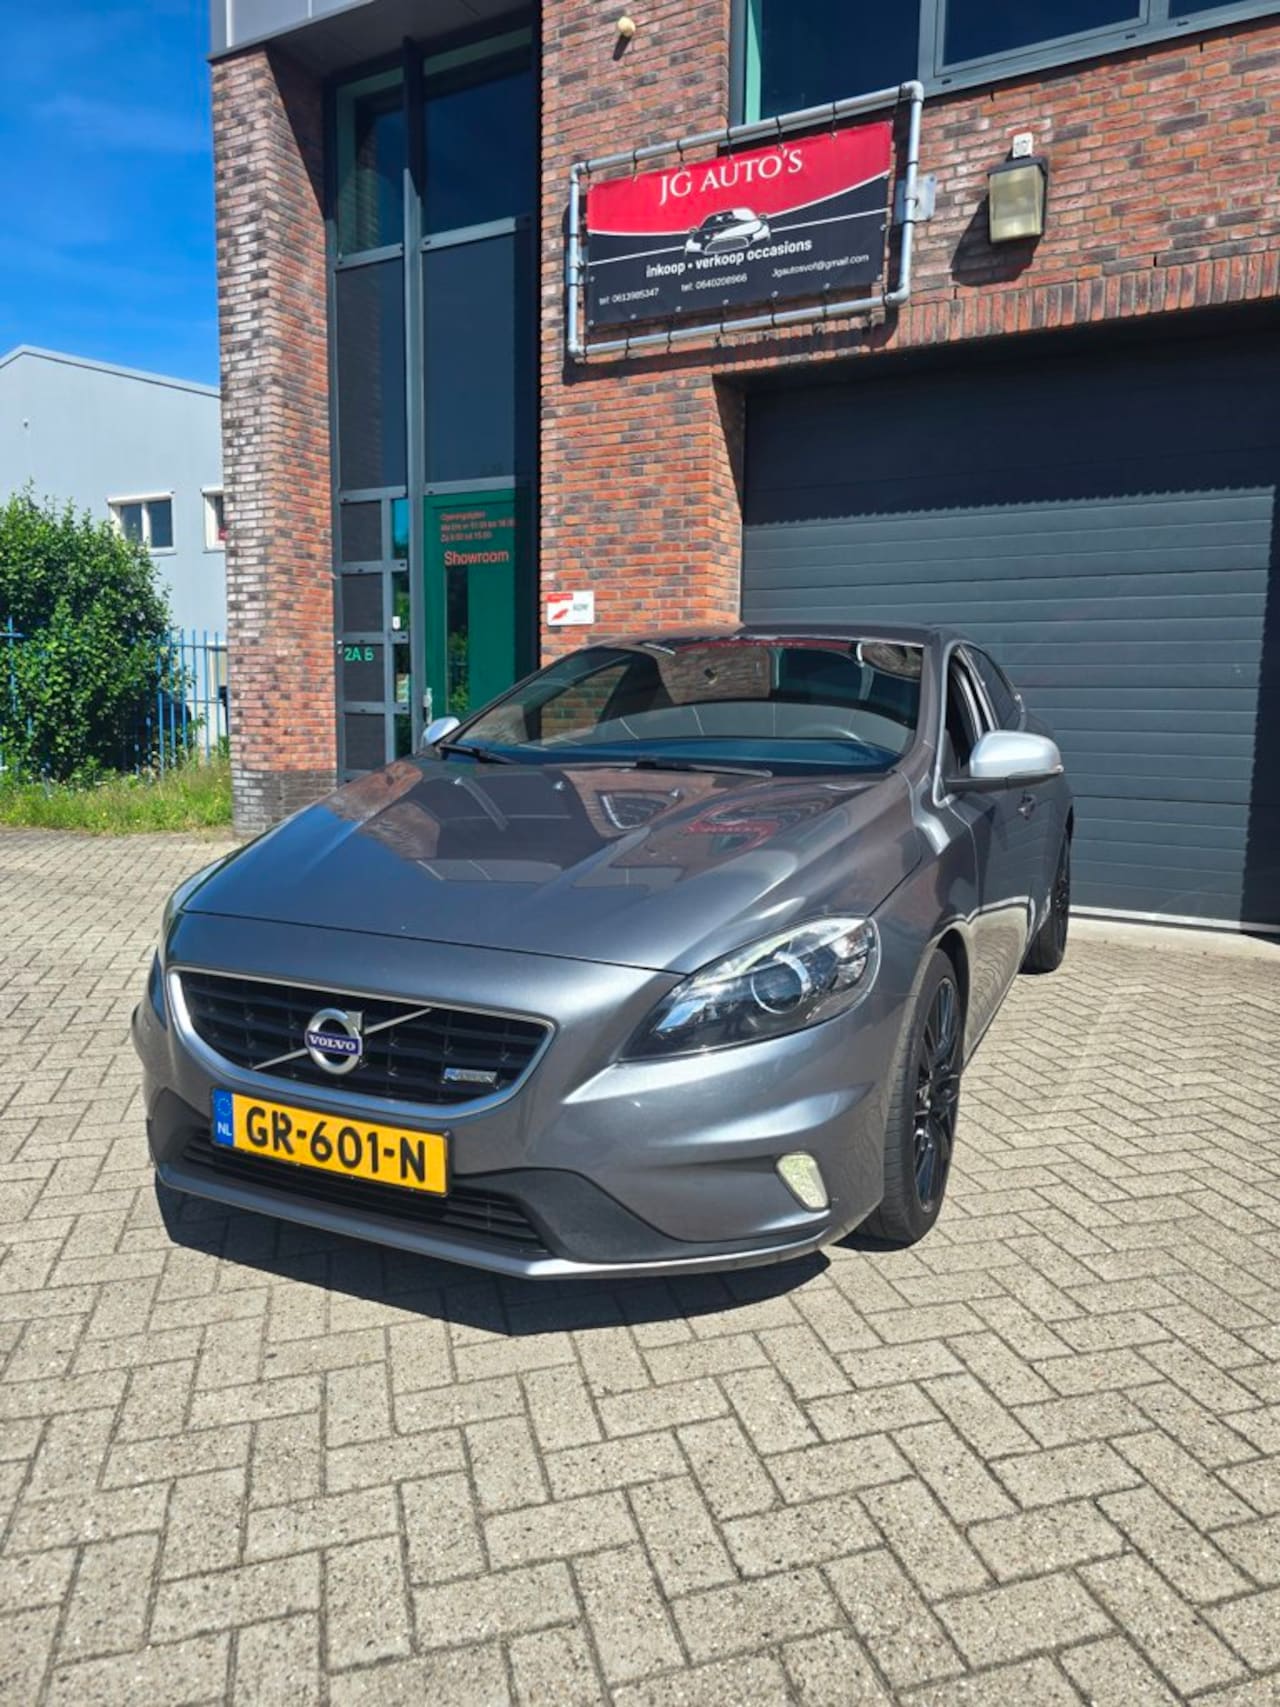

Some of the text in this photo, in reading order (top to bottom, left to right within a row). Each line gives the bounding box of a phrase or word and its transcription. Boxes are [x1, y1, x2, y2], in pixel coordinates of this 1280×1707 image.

[659, 149, 804, 206] JG AUTO'S
[646, 238, 813, 279] inkoop verkoop occasions
[444, 551, 509, 566] Showroom
[344, 646, 362, 662] 2A
[308, 1034, 357, 1052] VOLVO
[217, 1121, 232, 1137] NL
[245, 1106, 426, 1183] GR-601-N
